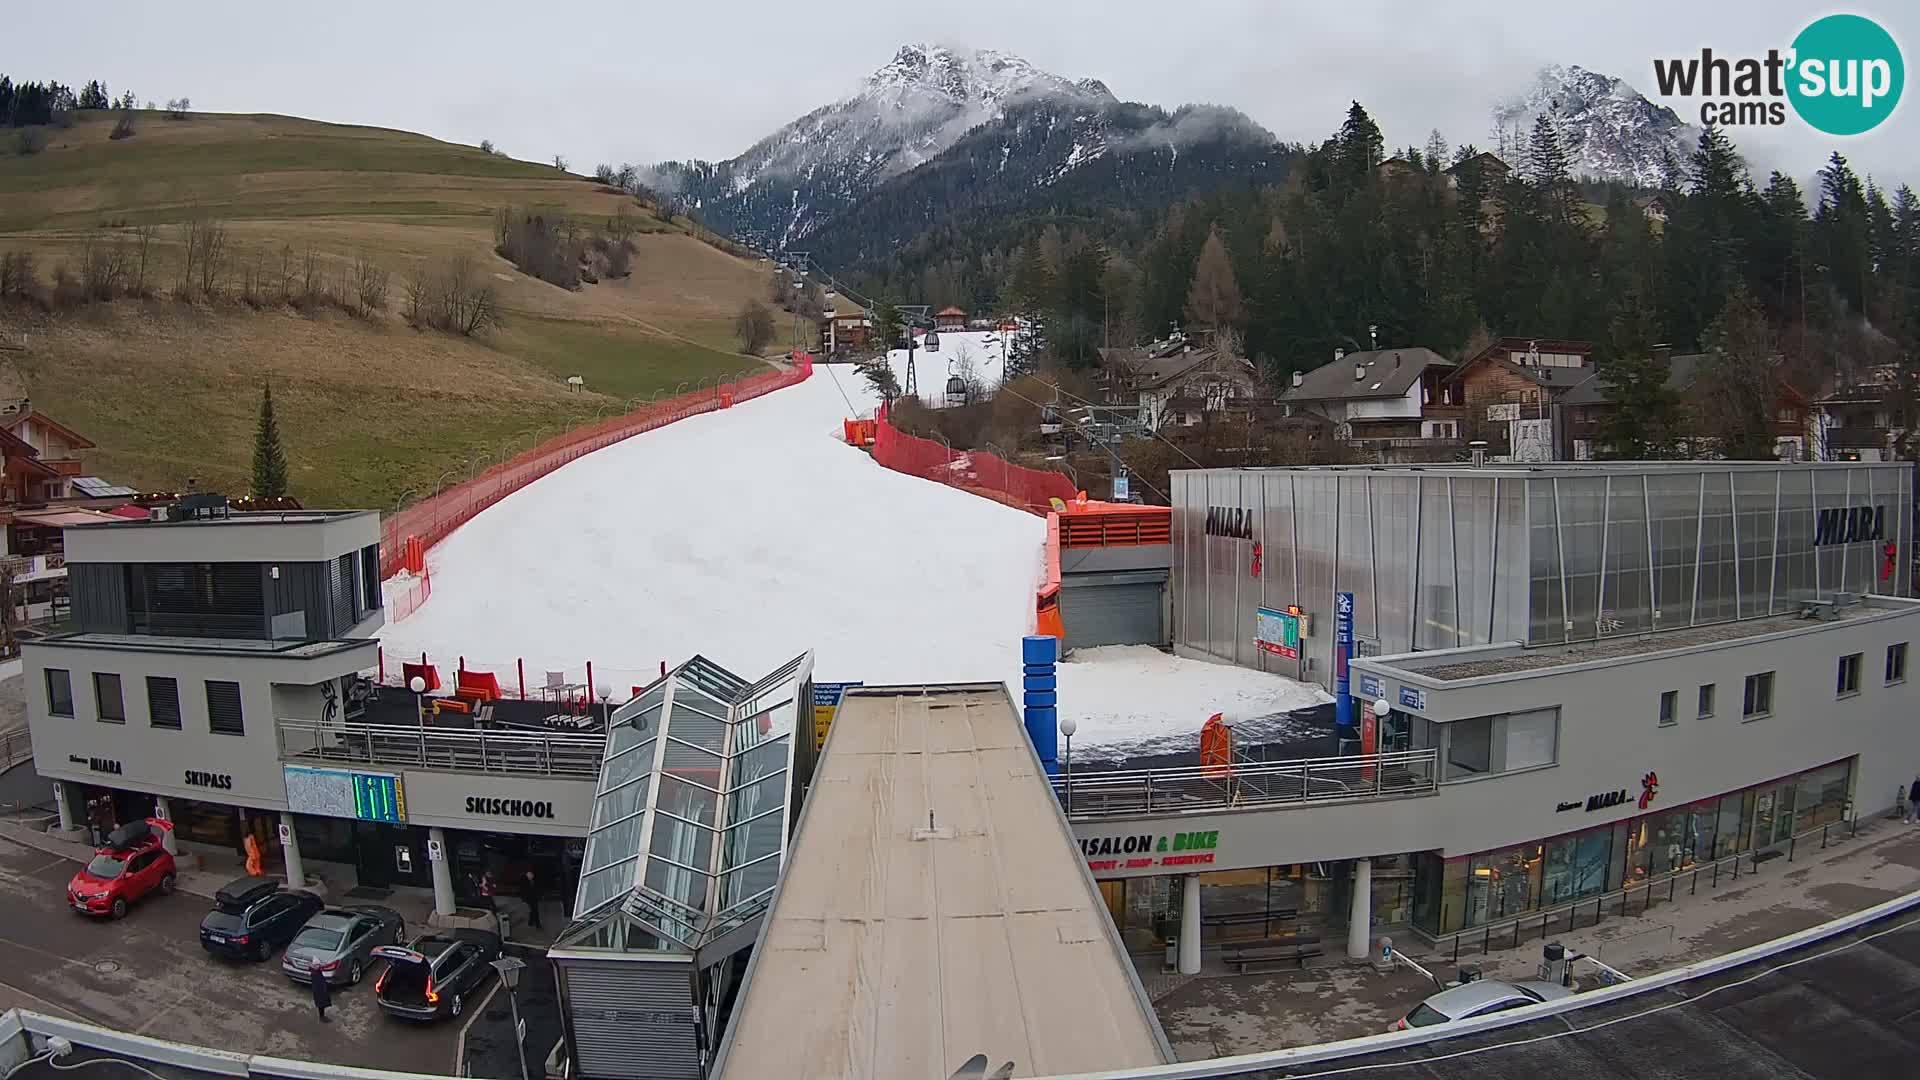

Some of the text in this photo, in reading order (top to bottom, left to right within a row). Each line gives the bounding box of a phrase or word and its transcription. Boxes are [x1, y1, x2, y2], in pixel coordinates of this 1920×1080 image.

[1206, 506, 1253, 540] MIARA
[1814, 505, 1884, 546] MIARA
[90, 757, 122, 776] MIARA
[185, 770, 232, 790] SKIPASS
[465, 796, 554, 819] SKISCHOOL
[1585, 789, 1626, 812] MIARA
[1156, 836, 1169, 852] &
[1173, 830, 1219, 851] BIKE
